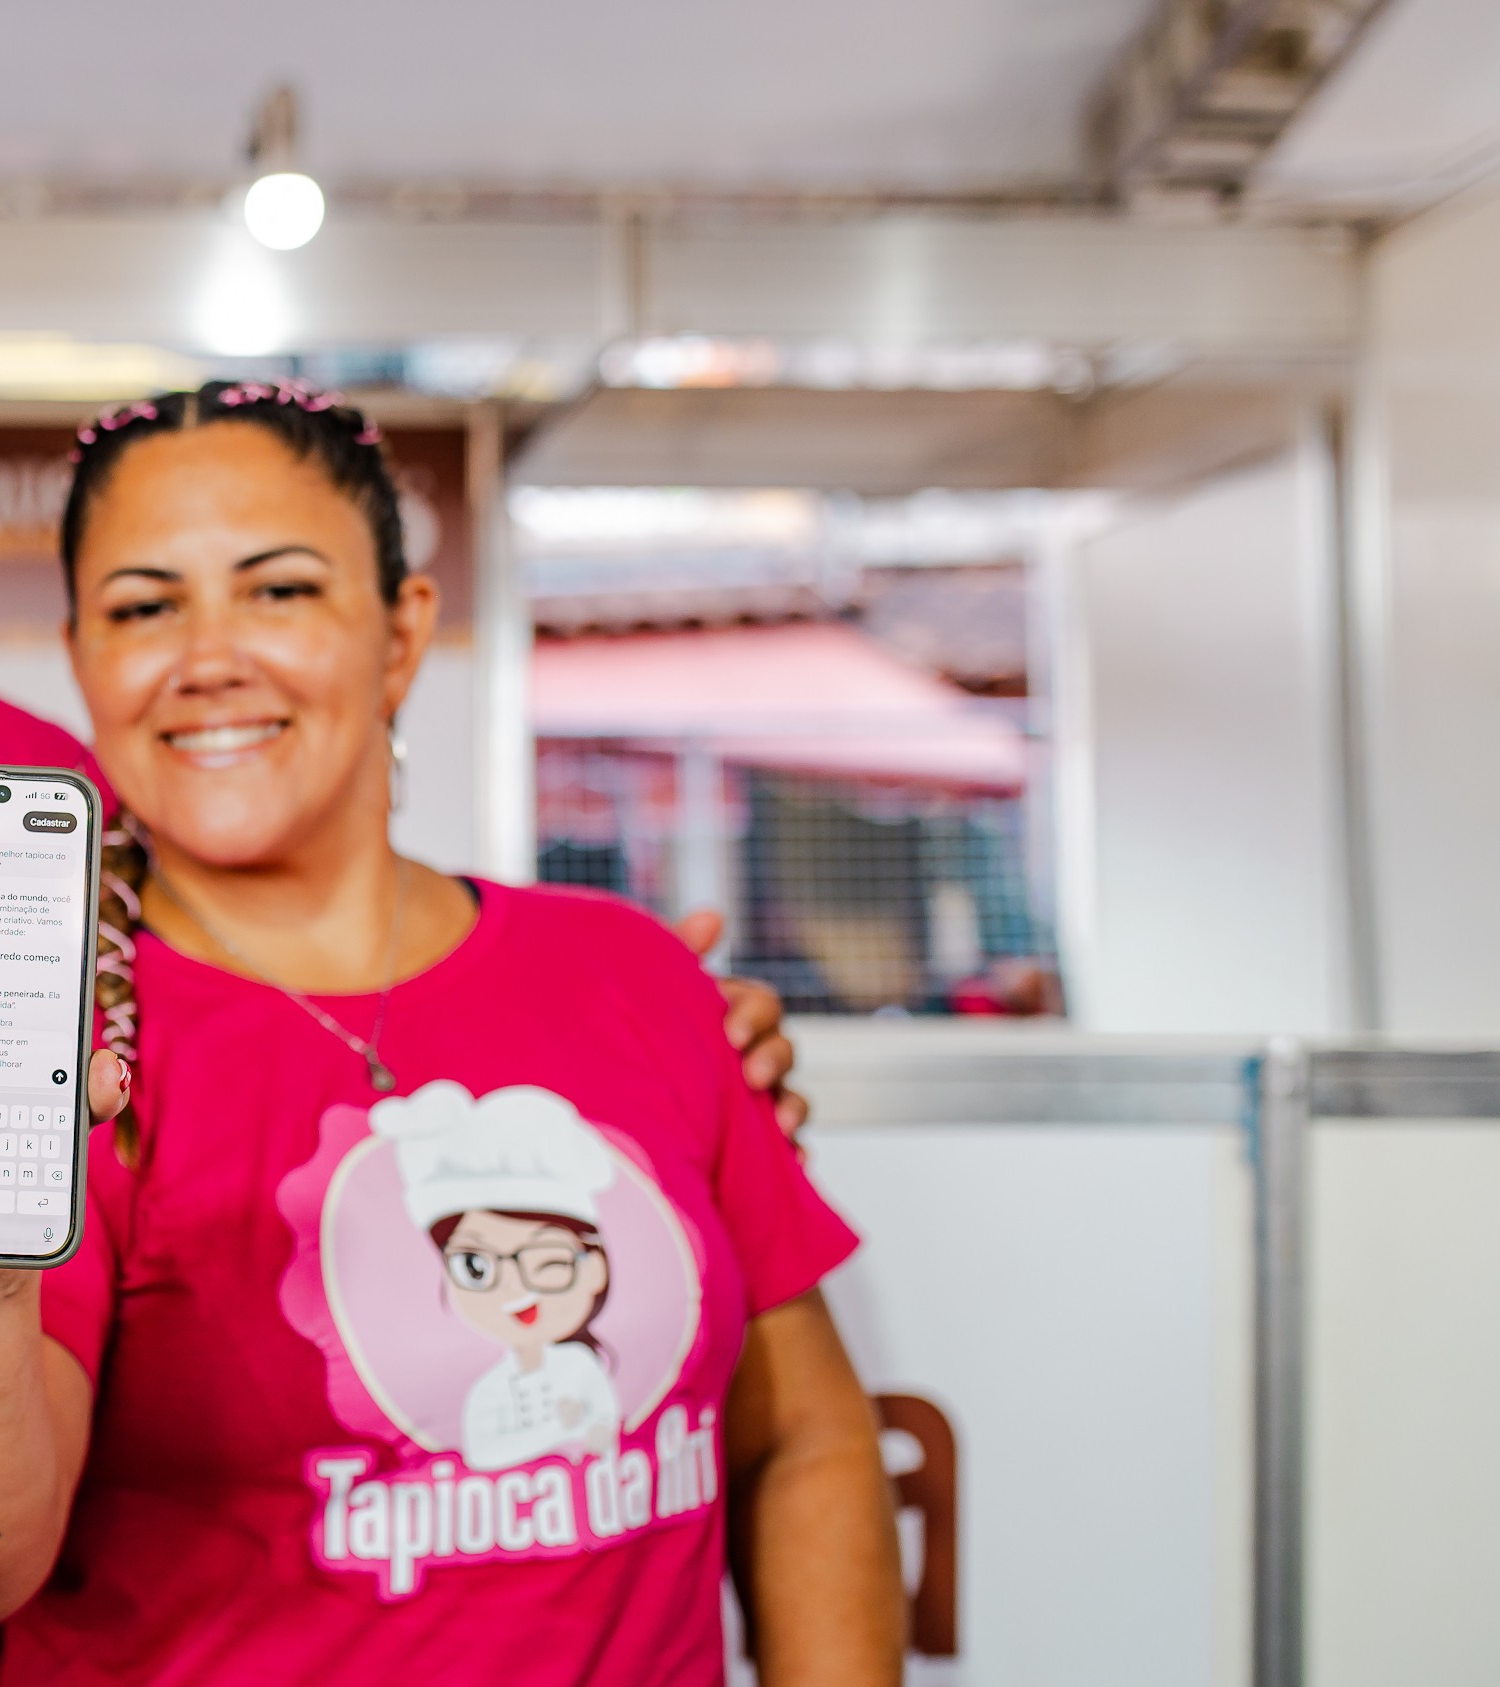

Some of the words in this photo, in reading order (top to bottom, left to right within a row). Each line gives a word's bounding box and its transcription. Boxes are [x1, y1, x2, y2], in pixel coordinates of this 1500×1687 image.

[30, 817, 70, 828] Cadastrar
[25, 851, 54, 860] tapioca
[55, 852, 66, 860] do
[7, 893, 18, 901] do
[39, 906, 50, 914] de
[36, 917, 63, 926] Vamos
[23, 954, 61, 964] começa
[48, 991, 61, 999] Ela
[37, 1113, 45, 1122] o
[59, 1114, 66, 1124] p
[26, 1139, 33, 1150] k
[3, 1169, 10, 1177] n
[23, 1170, 33, 1178] m
[315, 1457, 580, 1595] Tapioca
[584, 1442, 652, 1539] da
[655, 1402, 719, 1520] Ari
